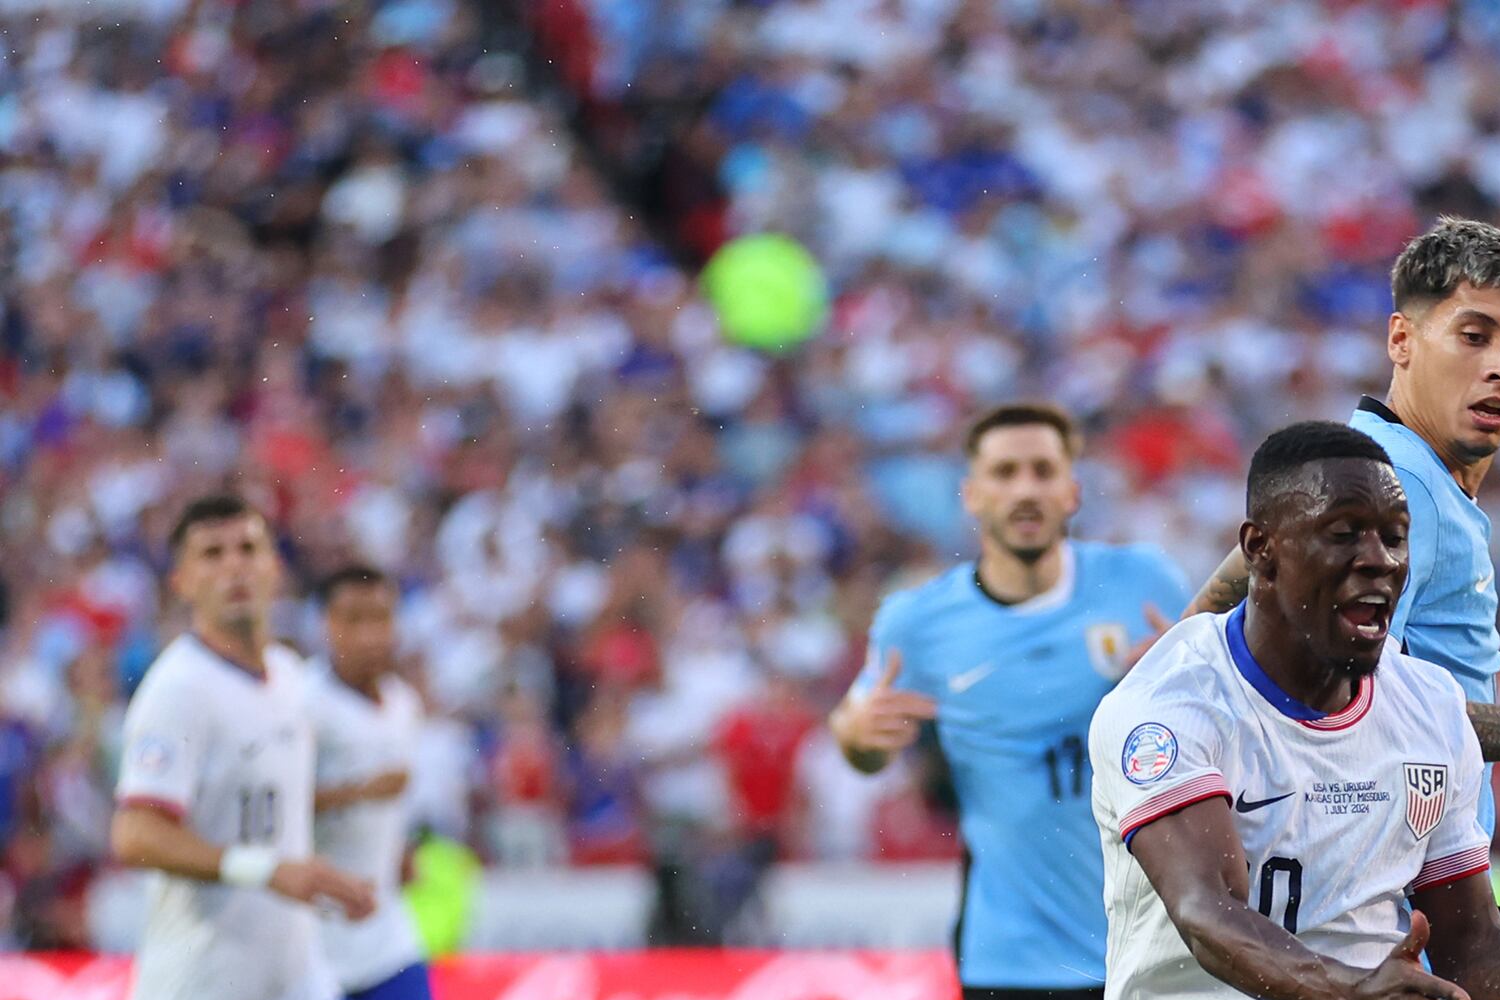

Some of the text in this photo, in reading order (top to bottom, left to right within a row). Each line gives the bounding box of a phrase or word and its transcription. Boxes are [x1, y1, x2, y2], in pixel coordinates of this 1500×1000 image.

[1313, 782, 1327, 793] USA
[1343, 780, 1377, 792] URUGUAY
[1407, 768, 1444, 797] USA
[1304, 791, 1332, 804] KANSAS
[1357, 791, 1391, 803] MISSOURI
[1325, 803, 1370, 815] 1 JULY 2024
[1246, 856, 1303, 935] 0
